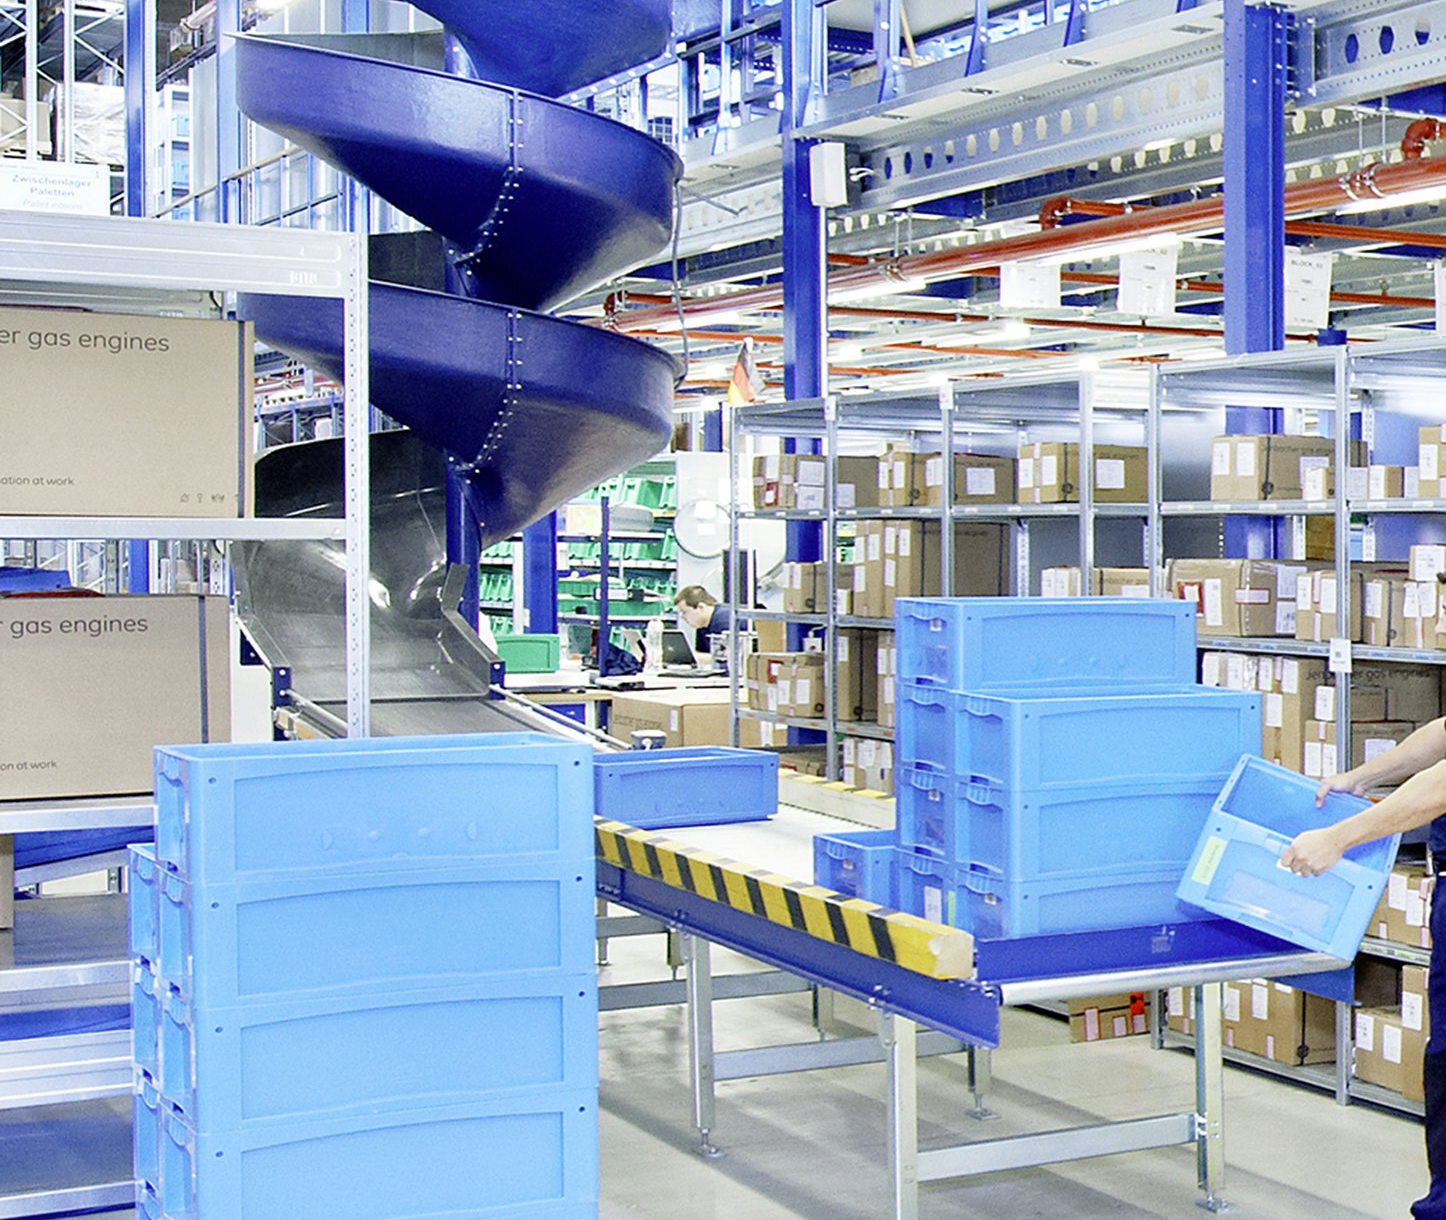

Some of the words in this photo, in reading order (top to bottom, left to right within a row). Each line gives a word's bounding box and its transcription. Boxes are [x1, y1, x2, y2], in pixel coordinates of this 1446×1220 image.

[12, 174, 92, 189] Zwischenlager
[30, 186, 75, 198] Paletten
[28, 331, 71, 350] gas
[78, 331, 170, 354] engines
[32, 477, 45, 486] at
[46, 477, 75, 487] work
[10, 619, 53, 640] gas
[59, 615, 149, 638] engines
[16, 761, 29, 771] at
[30, 759, 58, 770] work
